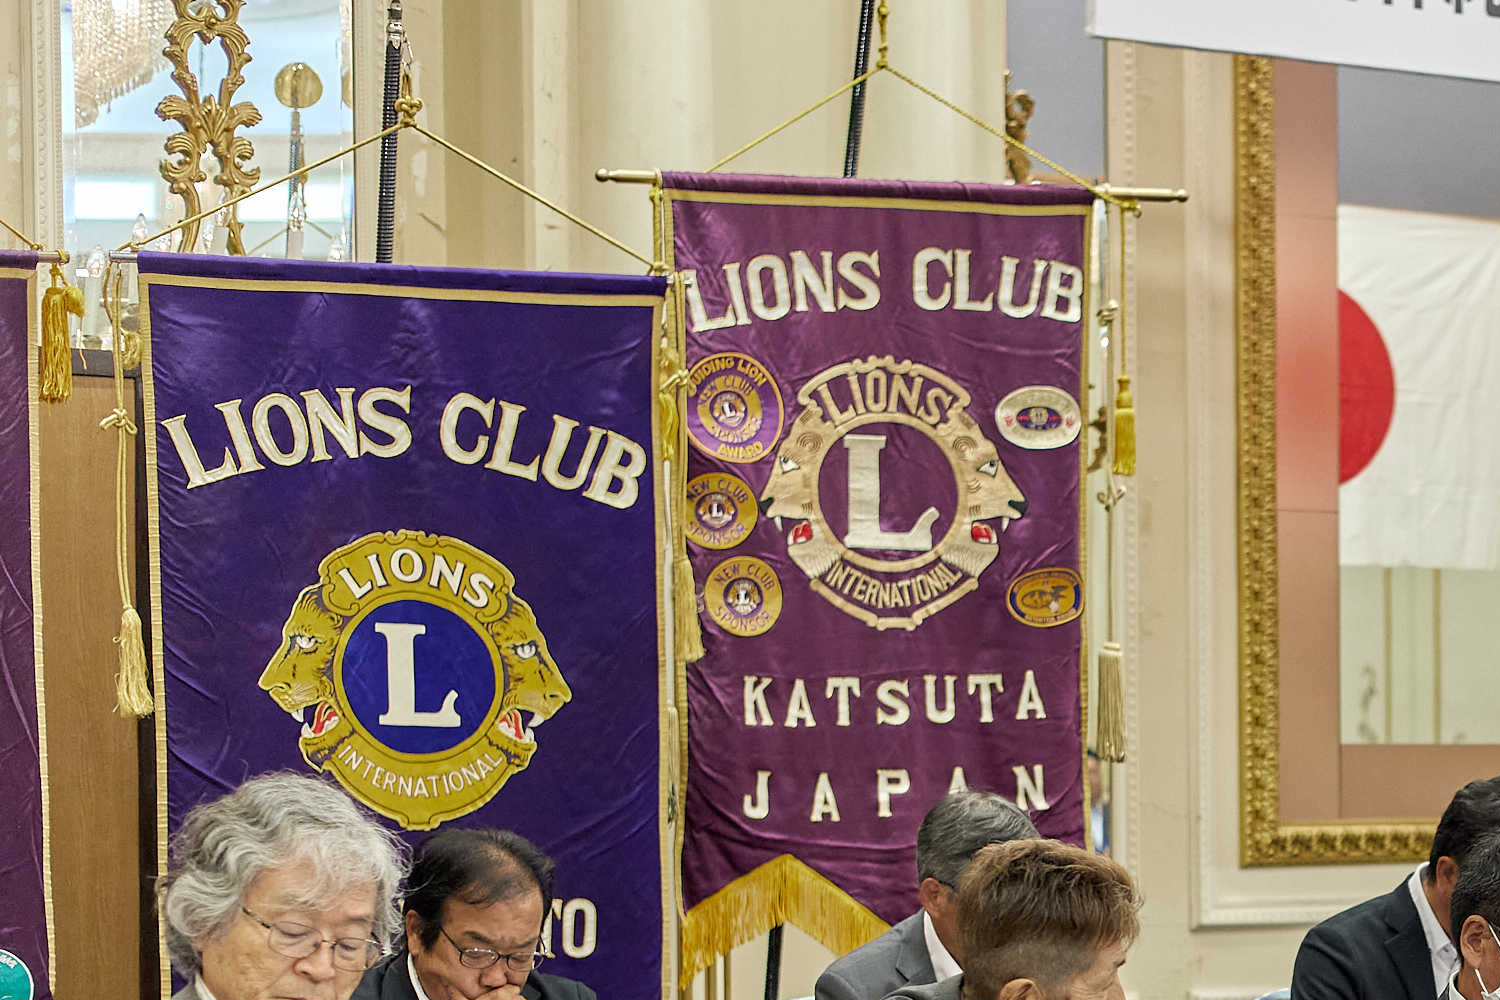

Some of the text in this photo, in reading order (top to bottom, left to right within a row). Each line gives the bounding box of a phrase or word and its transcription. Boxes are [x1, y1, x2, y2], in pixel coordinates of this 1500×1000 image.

[685, 247, 1083, 333] LIONS CLUB
[690, 356, 768, 387] UIDING LION
[723, 374, 753, 396] CLUB
[825, 368, 956, 431] LIONS
[161, 385, 647, 510] LIONS CLUB
[717, 440, 764, 459] AWARD
[687, 479, 749, 504] NEW CLUB
[842, 434, 940, 551] L
[686, 521, 748, 545] SPONSOR
[338, 549, 495, 611] LIONS
[714, 563, 776, 591] NEW CLUB
[827, 561, 963, 609] INTERNATIONAL
[714, 606, 773, 632] SPONSOR
[374, 622, 461, 726] L
[742, 669, 1048, 729] KATSUTA
[337, 743, 502, 798] INTERNATIONAL
